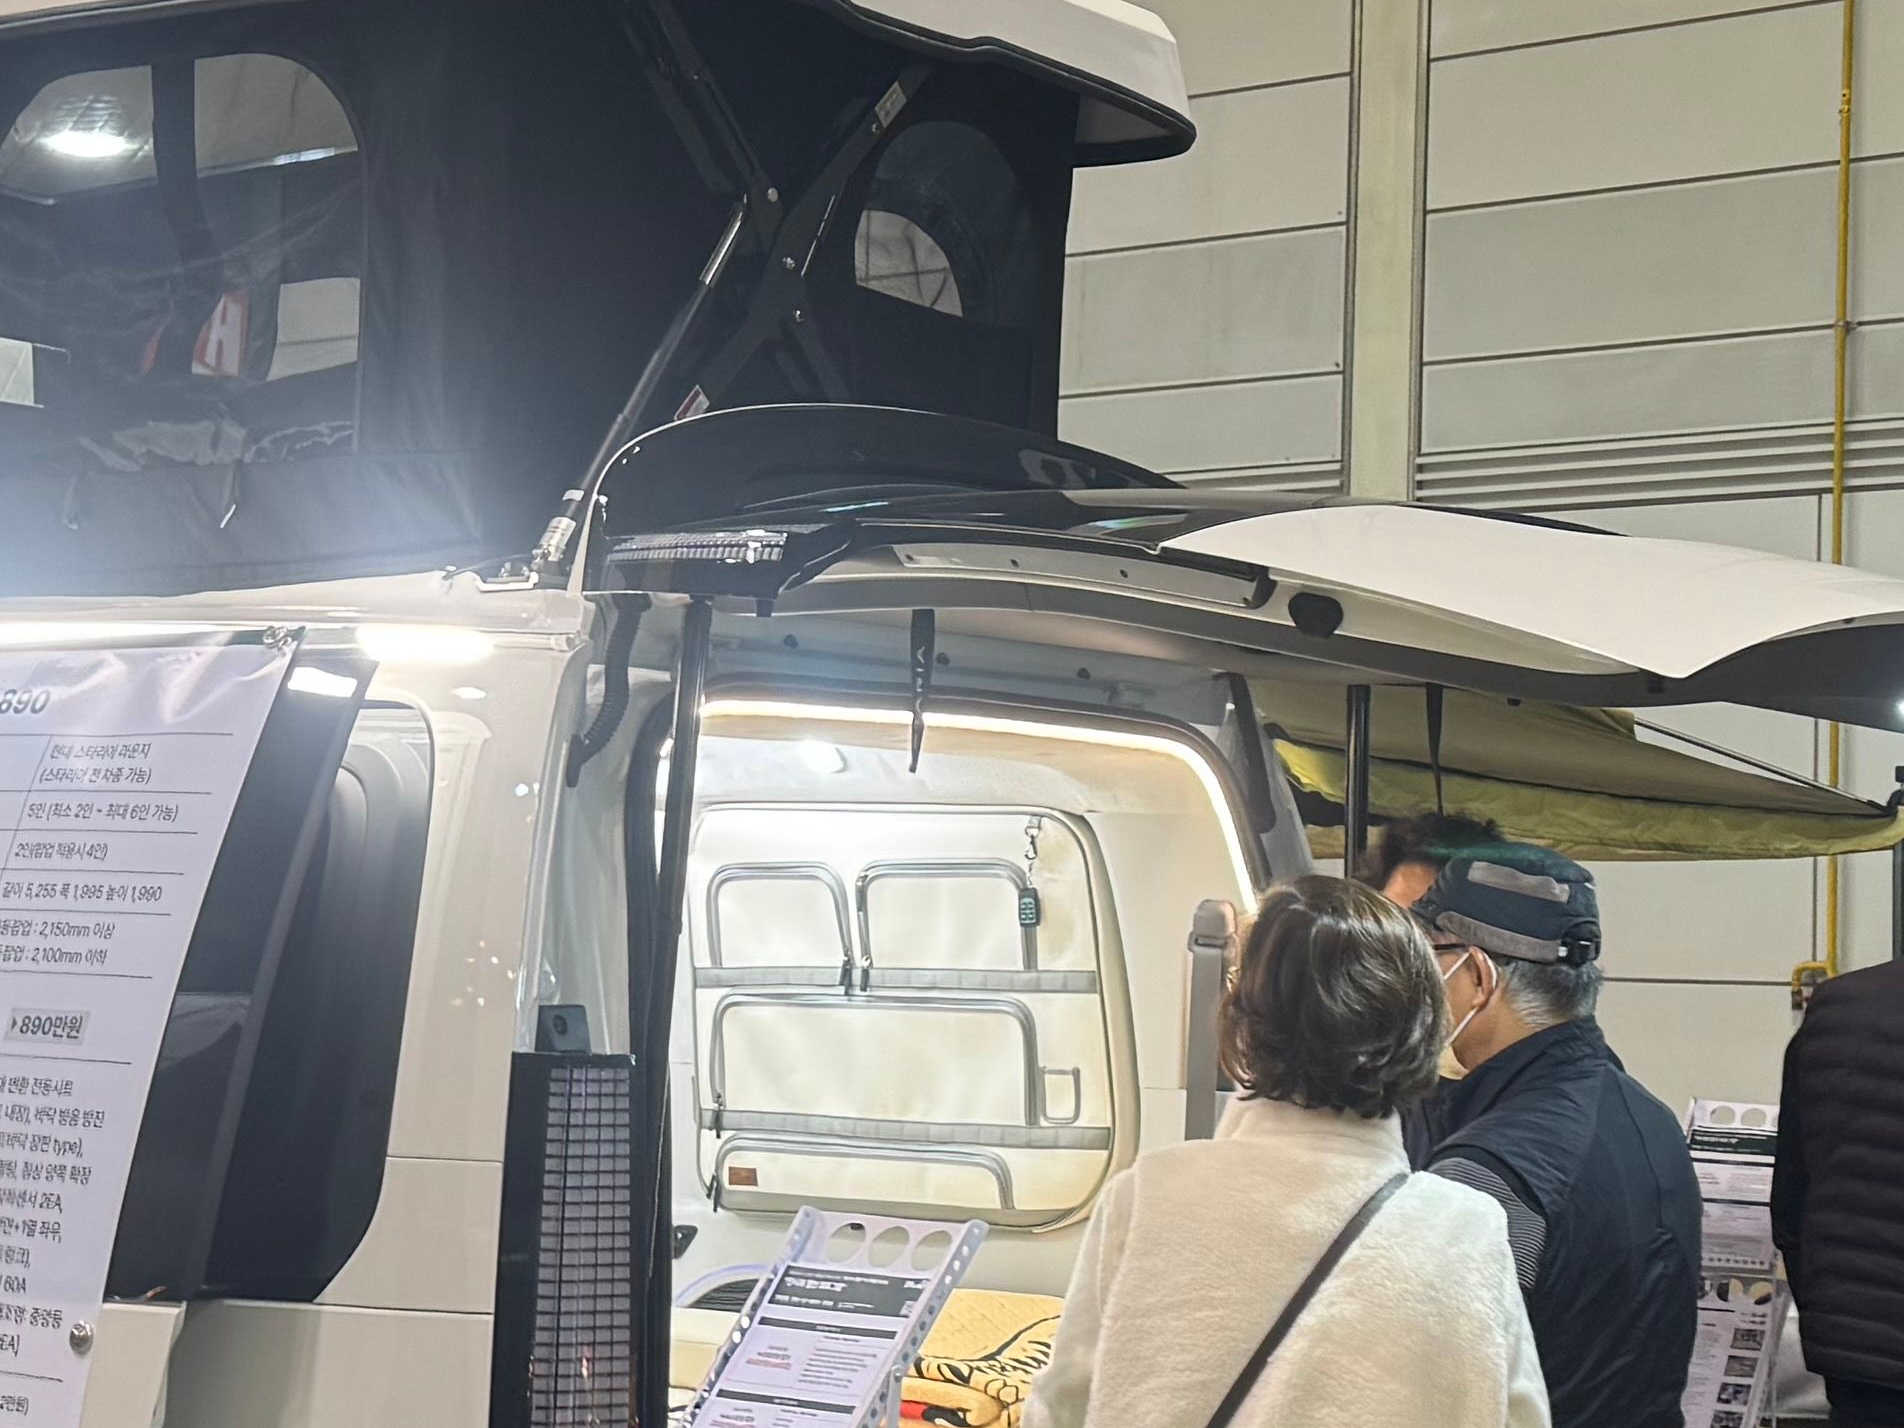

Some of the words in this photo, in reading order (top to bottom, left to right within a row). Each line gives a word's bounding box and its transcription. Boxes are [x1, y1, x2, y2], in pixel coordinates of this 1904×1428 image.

[117, 742, 152, 760] 라운지
[124, 766, 153, 785] 가능)
[46, 802, 73, 821] (최소
[74, 803, 95, 820] 2인
[107, 803, 129, 821] 최대
[129, 803, 150, 821] 6인
[151, 803, 179, 823] 가능)
[24, 881, 58, 900] 5,255
[59, 883, 72, 900] 폭
[105, 883, 128, 902] 높이
[38, 921, 91, 940] 2,150mm
[92, 922, 115, 940] 이상
[30, 947, 83, 965] 2,100mm
[19, 1014, 84, 1041] 890만원
